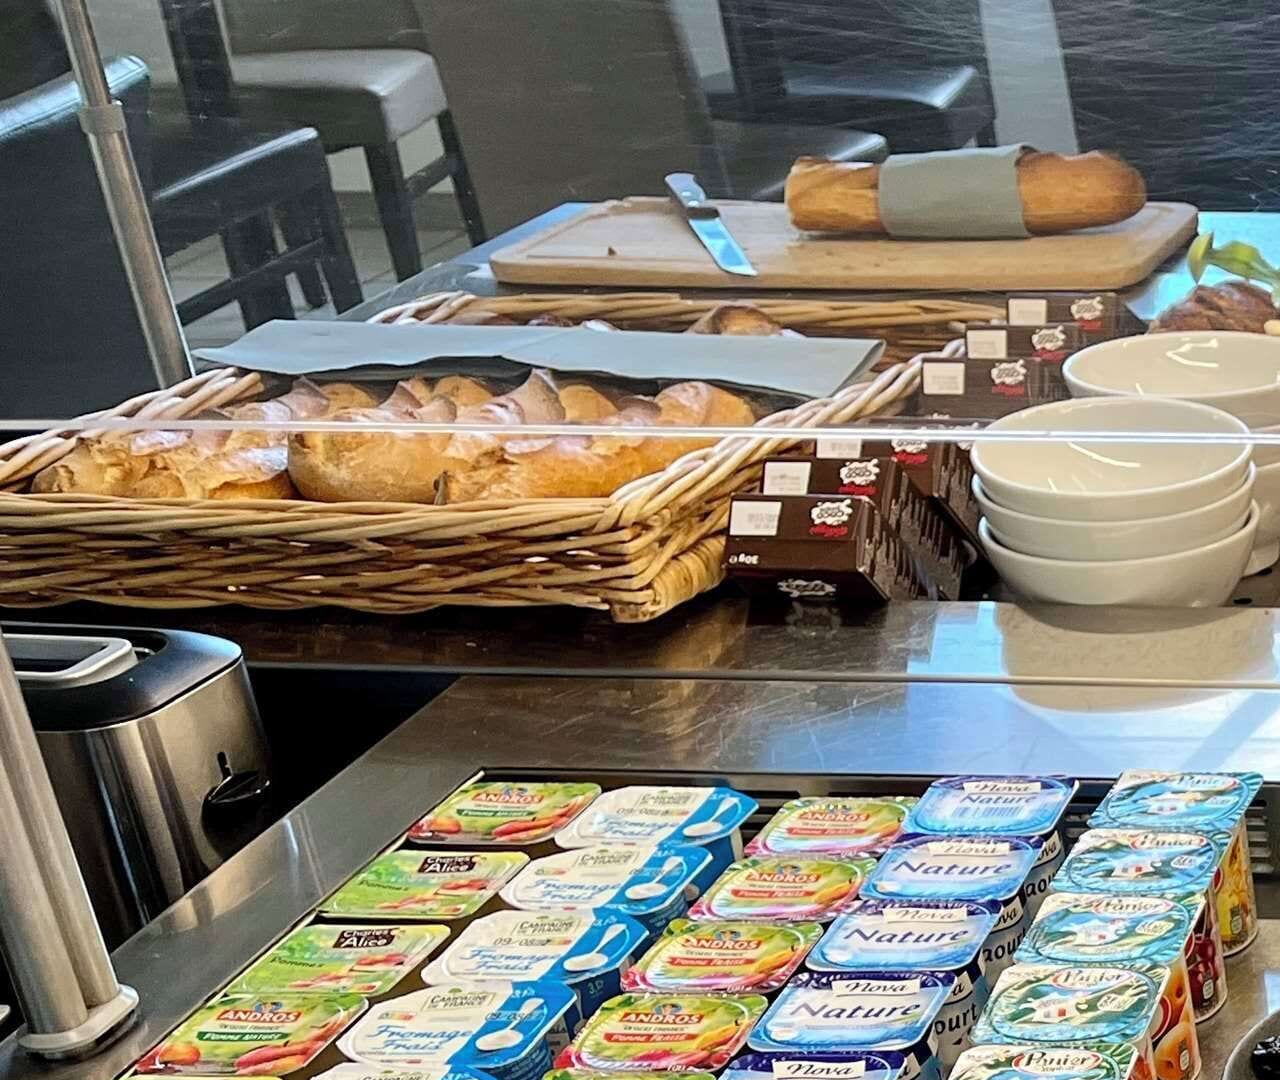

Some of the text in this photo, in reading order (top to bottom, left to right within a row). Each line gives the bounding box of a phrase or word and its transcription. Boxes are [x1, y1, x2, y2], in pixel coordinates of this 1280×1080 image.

[892, 860, 1013, 876] Nature
[749, 872, 818, 883] ANDROS
[685, 938, 759, 949] ANDROS
[843, 928, 970, 945] Nature
[844, 980, 909, 994] Nova
[220, 1010, 300, 1023] ANDROS
[791, 1002, 922, 1020] Nature
[623, 1013, 701, 1024] ANDROS
[365, 1025, 473, 1042] Fromage
[376, 1039, 442, 1052] Frais
[1021, 1052, 1092, 1068] Panier
[785, 1062, 854, 1076] Nova
